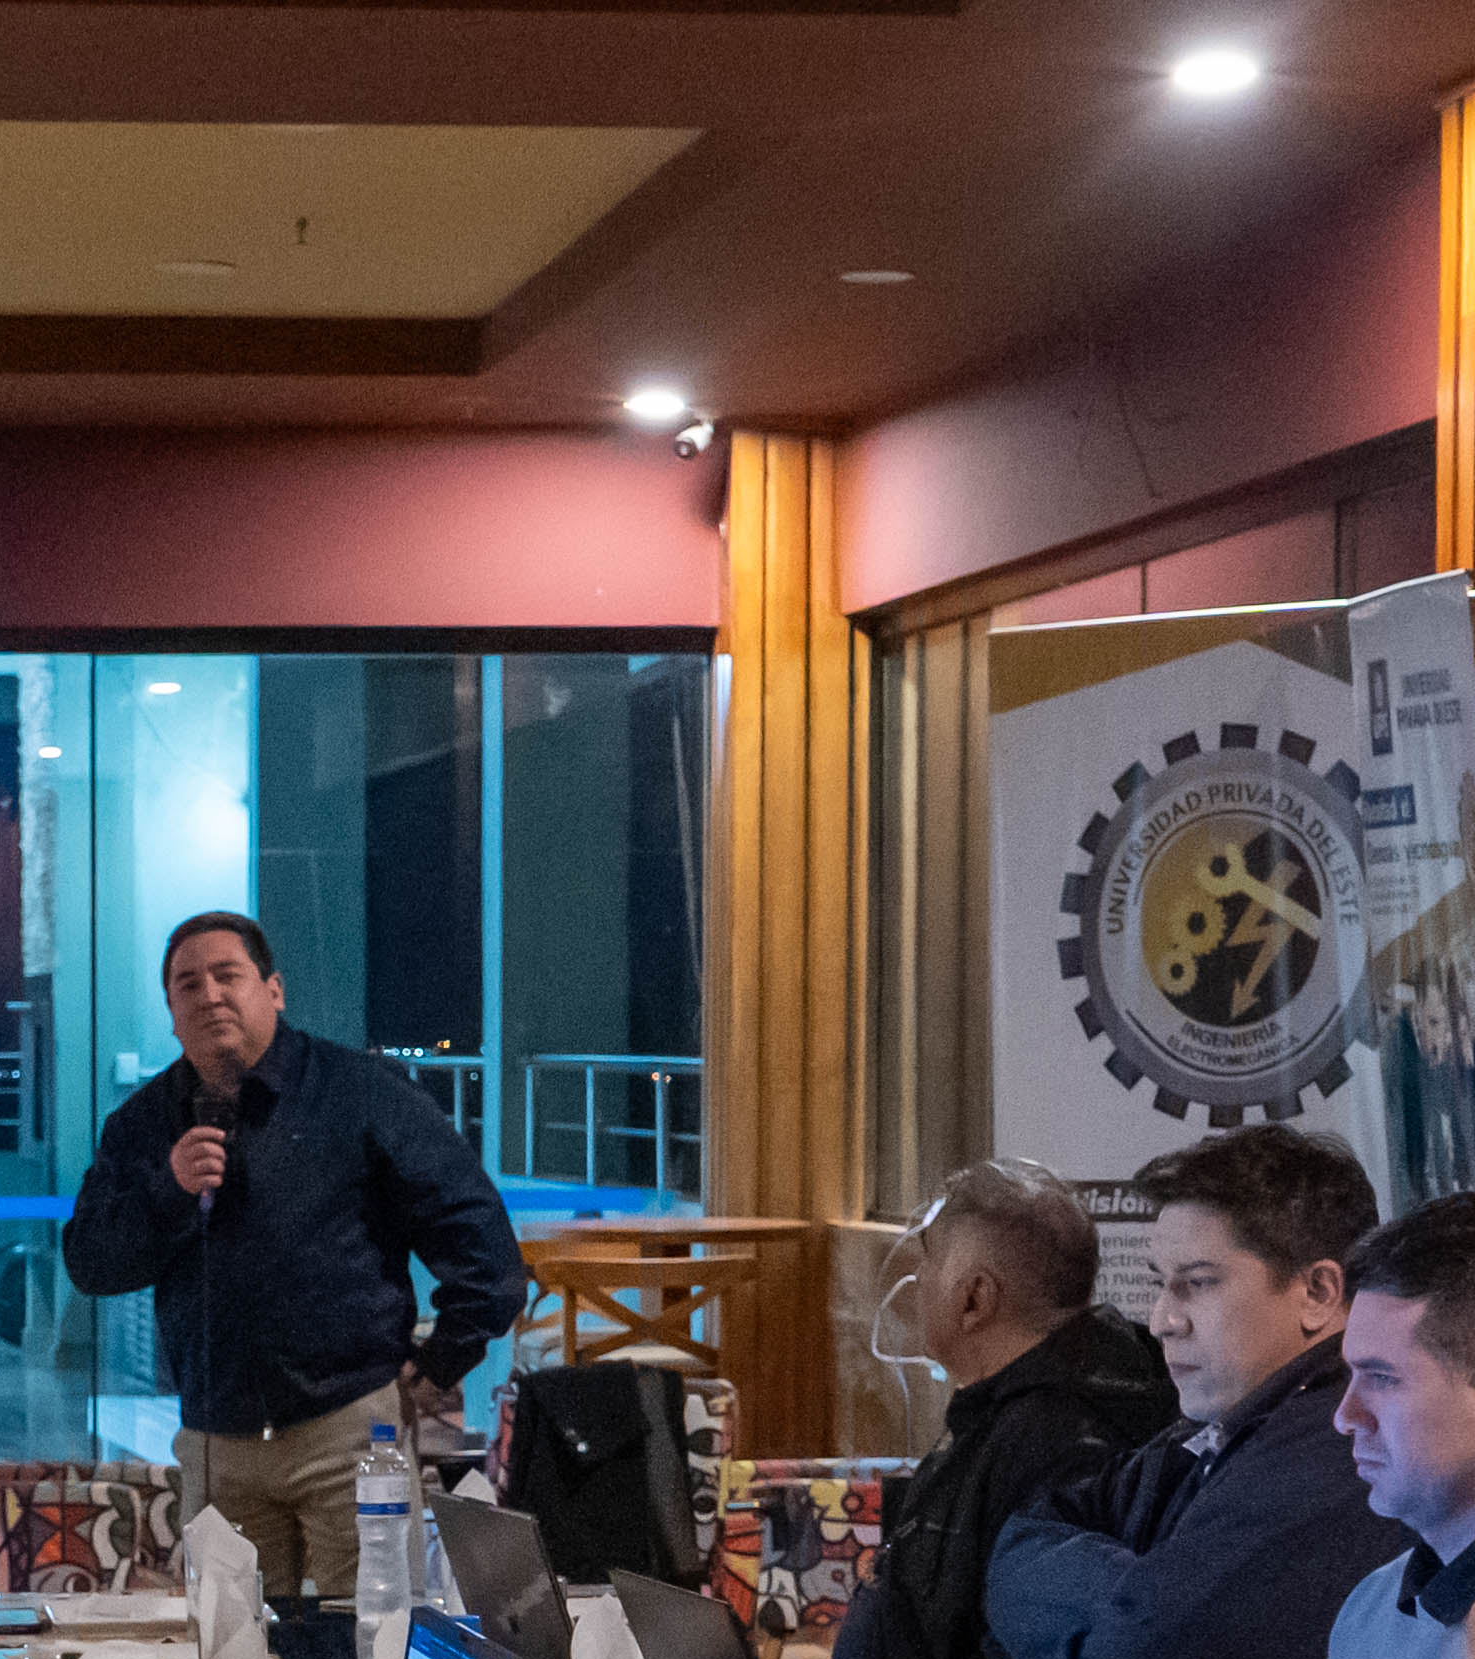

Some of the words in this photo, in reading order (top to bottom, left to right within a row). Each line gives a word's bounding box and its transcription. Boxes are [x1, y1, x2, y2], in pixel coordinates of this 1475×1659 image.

[1107, 789, 1202, 935] UNIVERSIDAD
[1208, 782, 1306, 825] PRIVADA
[1306, 818, 1339, 864] DEL
[1331, 864, 1361, 925] ESTE
